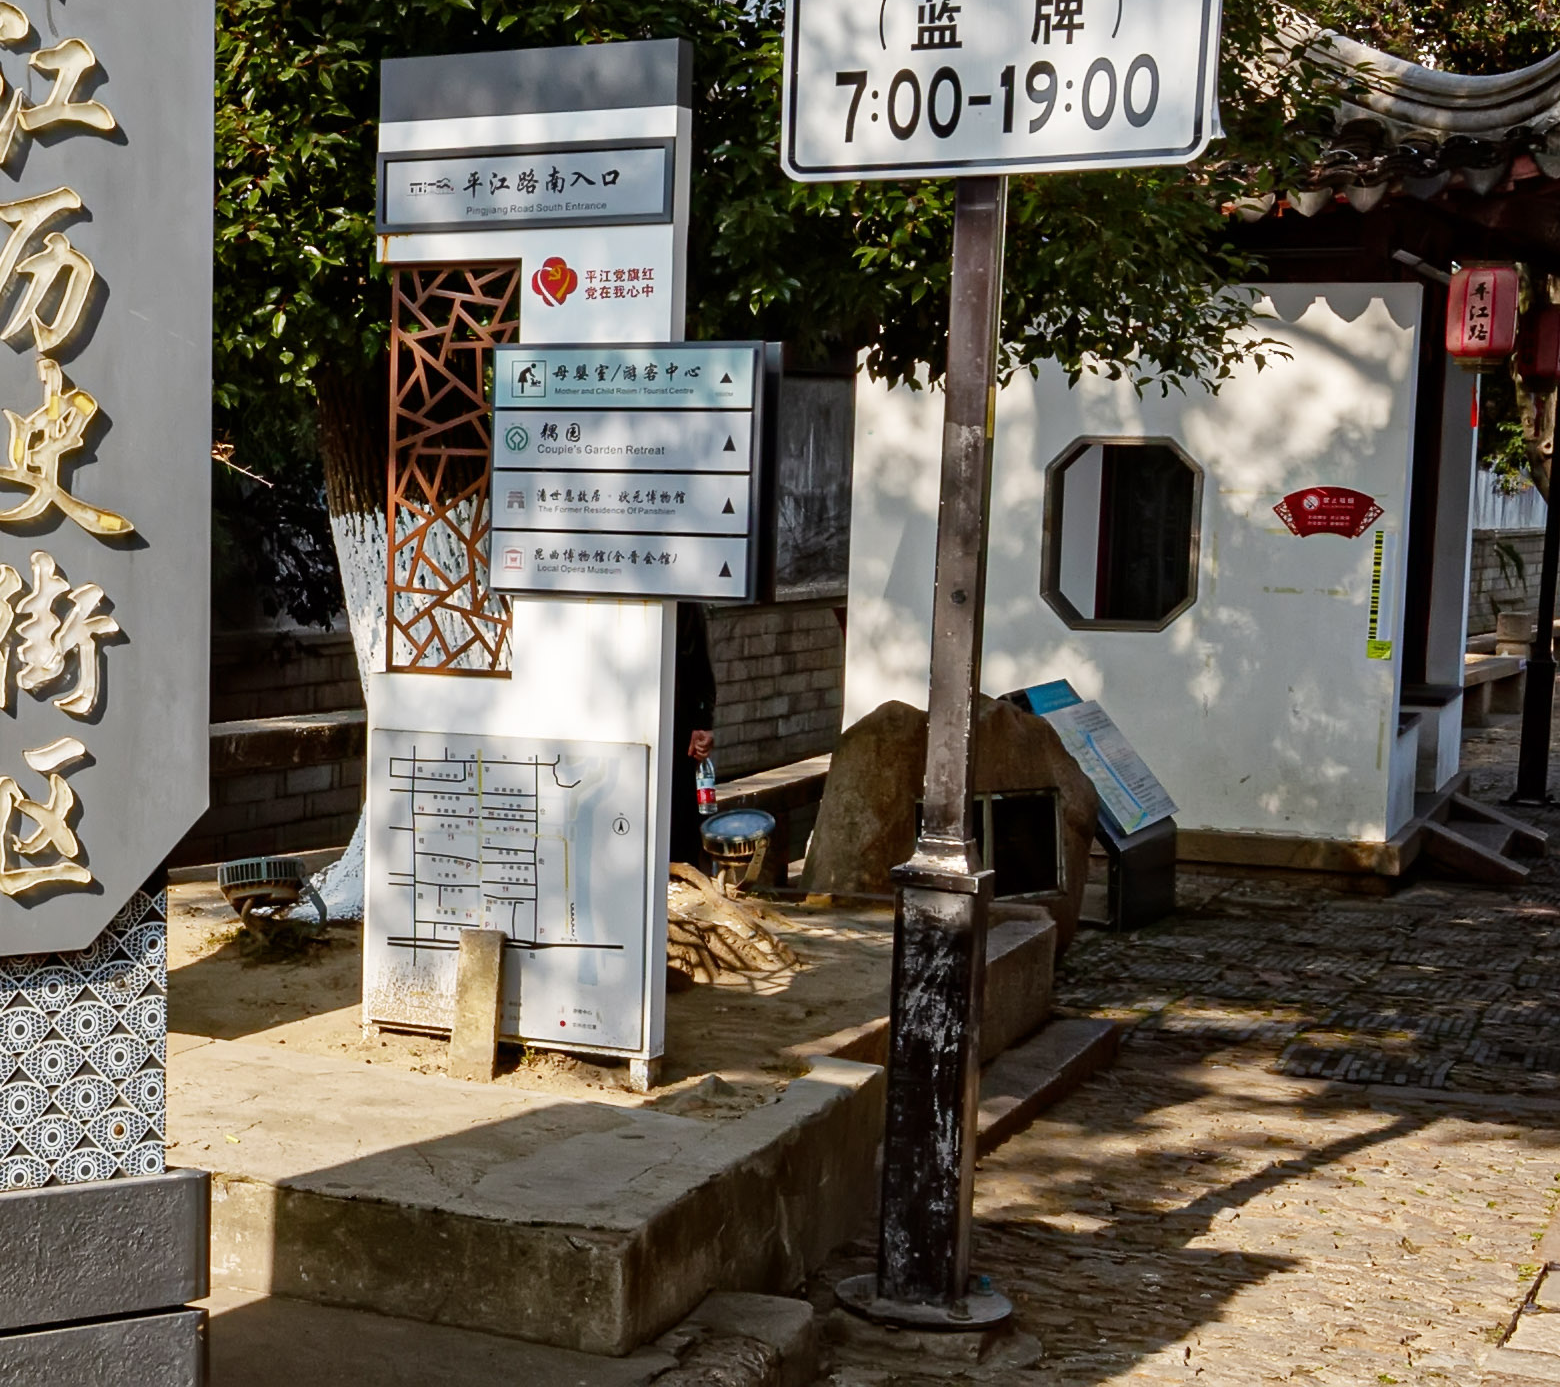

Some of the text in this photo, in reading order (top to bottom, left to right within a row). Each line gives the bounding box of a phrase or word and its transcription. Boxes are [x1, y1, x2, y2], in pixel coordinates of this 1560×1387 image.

[836, 54, 1159, 143] 7:00-19:00
[463, 166, 620, 198] 平江路南入口
[466, 200, 607, 215] Pingjiang Road South Entrance
[585, 268, 655, 283] 平江党旗红
[585, 284, 655, 300] 党在我心中
[1468, 281, 1490, 341] 平江路
[554, 387, 580, 395] Mother
[595, 387, 614, 395] Child
[616, 387, 638, 395] Room
[643, 387, 667, 395] Tourist
[669, 387, 694, 395] Centre
[539, 422, 581, 442] 耦园
[584, 445, 623, 455] Garden
[625, 445, 665, 455] Retreat
[539, 505, 552, 513] The
[584, 506, 625, 514] Residence
[627, 507, 637, 515] Of
[537, 564, 622, 575] Local Opera Museum
